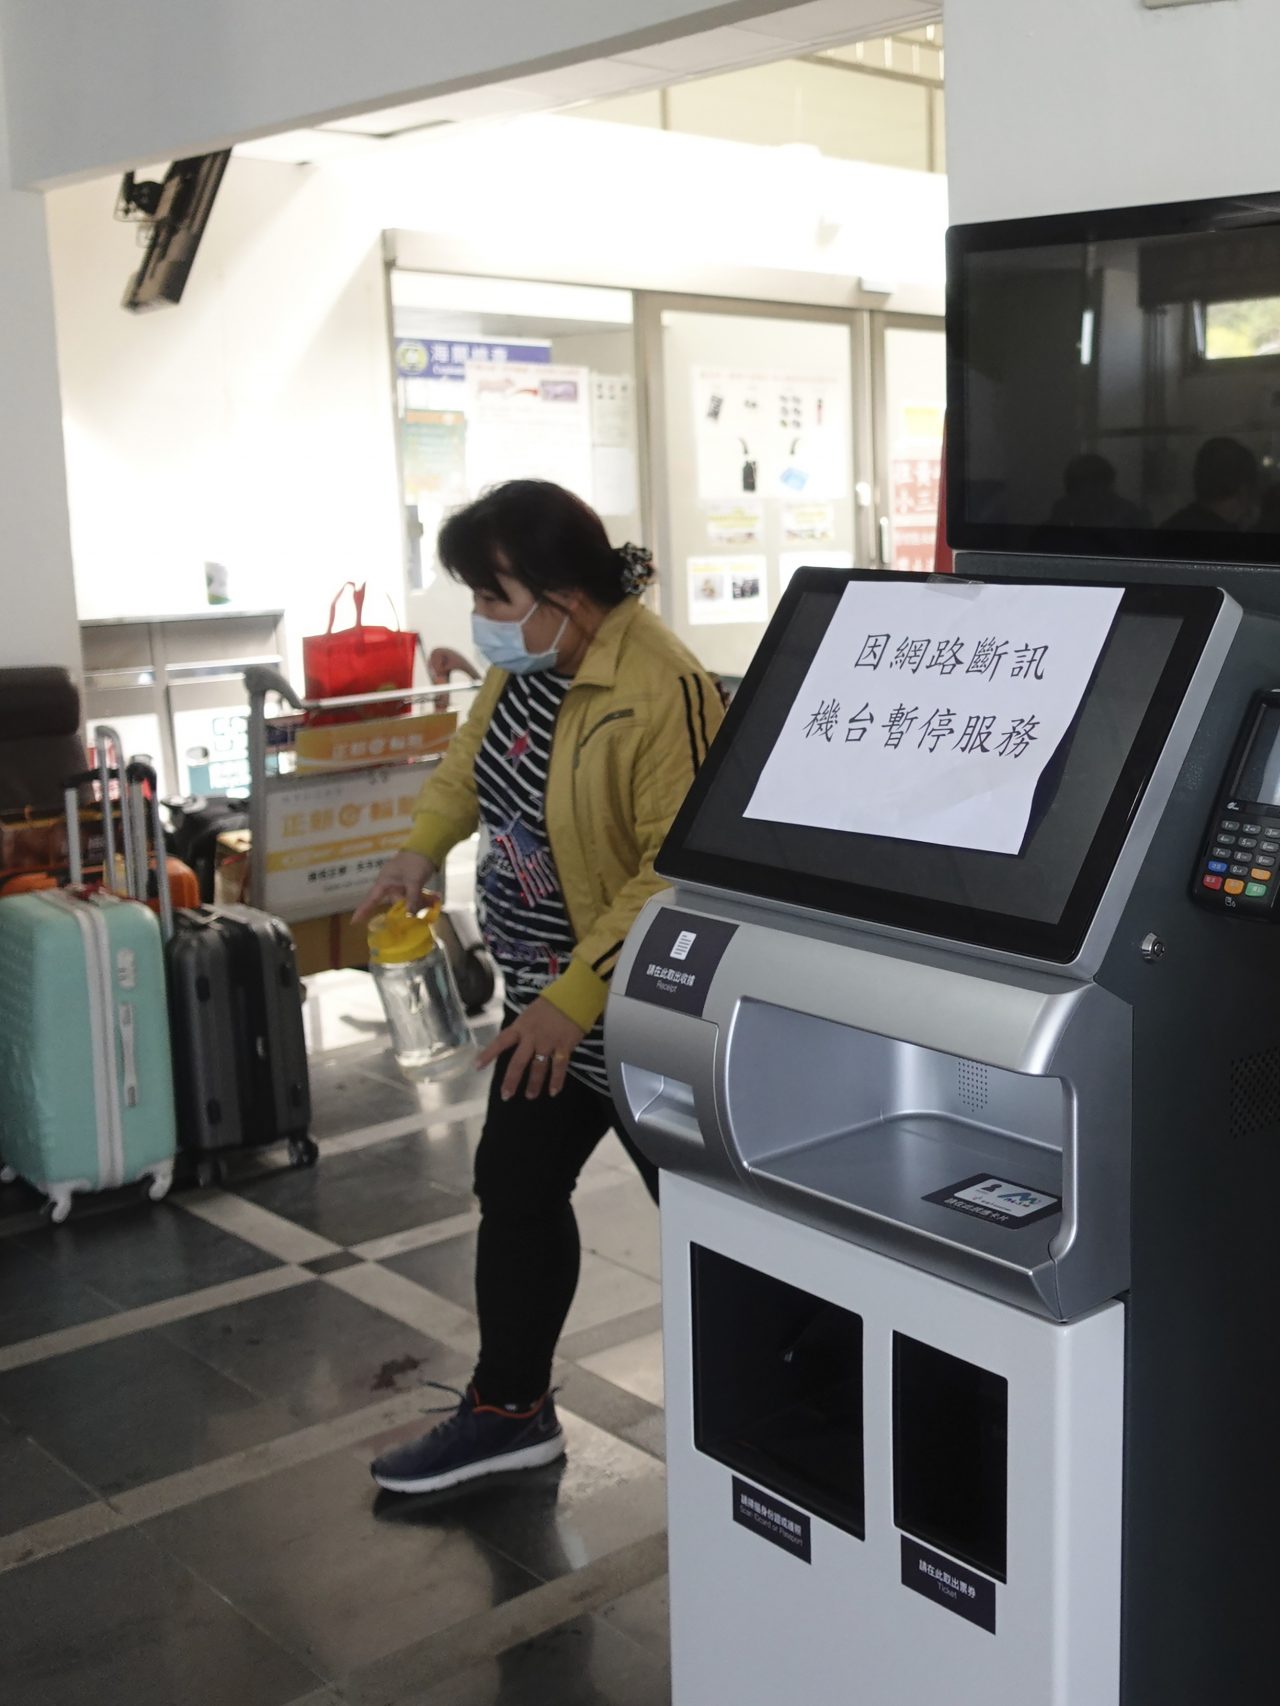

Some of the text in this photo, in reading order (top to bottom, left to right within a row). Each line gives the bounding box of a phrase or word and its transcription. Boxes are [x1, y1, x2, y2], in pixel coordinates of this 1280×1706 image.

[854, 633, 1050, 682] 因網路斷訊
[802, 697, 1041, 759] 機台暫停服務
[919, 1559, 976, 1599] 請在此取出票券
